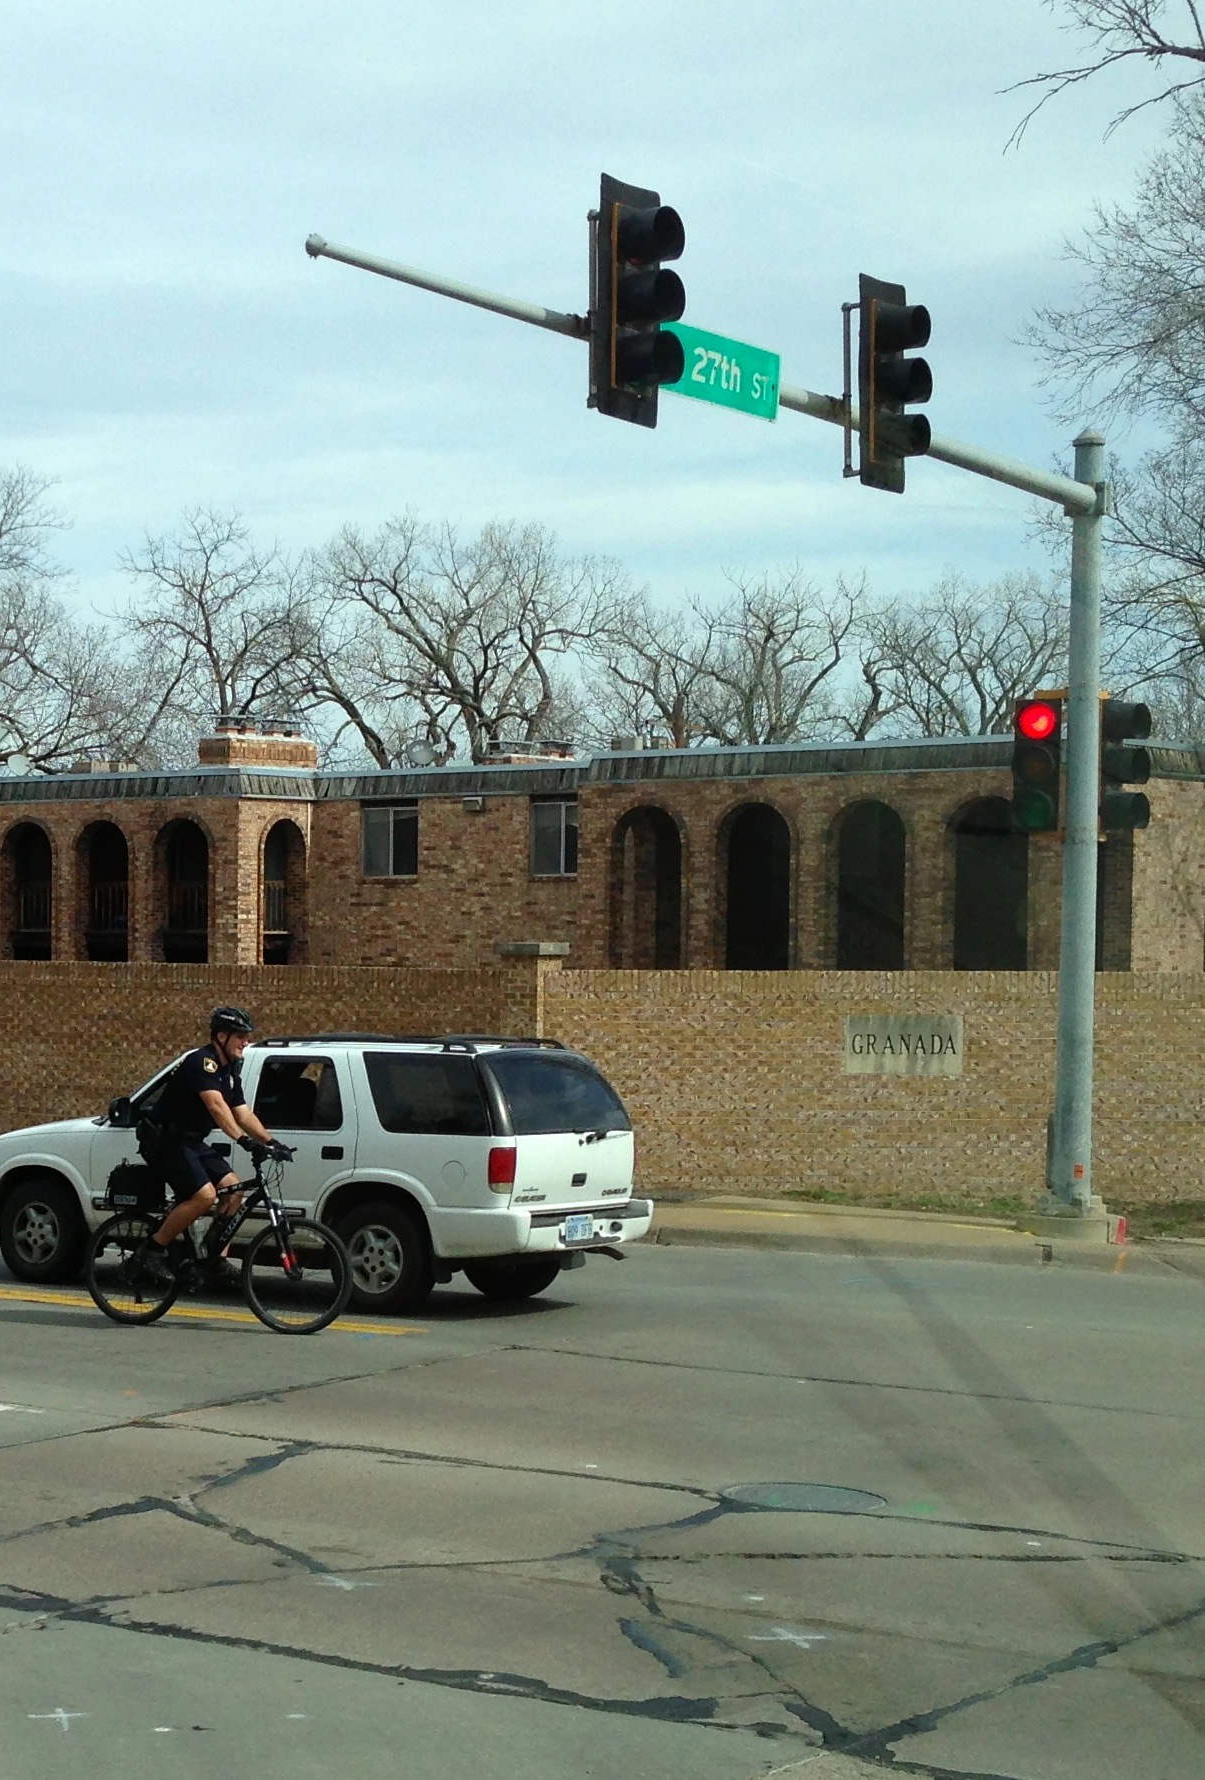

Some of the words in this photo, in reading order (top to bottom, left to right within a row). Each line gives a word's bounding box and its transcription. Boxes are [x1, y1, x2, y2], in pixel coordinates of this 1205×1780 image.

[691, 346, 741, 393] 27th
[751, 372, 771, 401] ST
[851, 1033, 956, 1055] GRANADA
